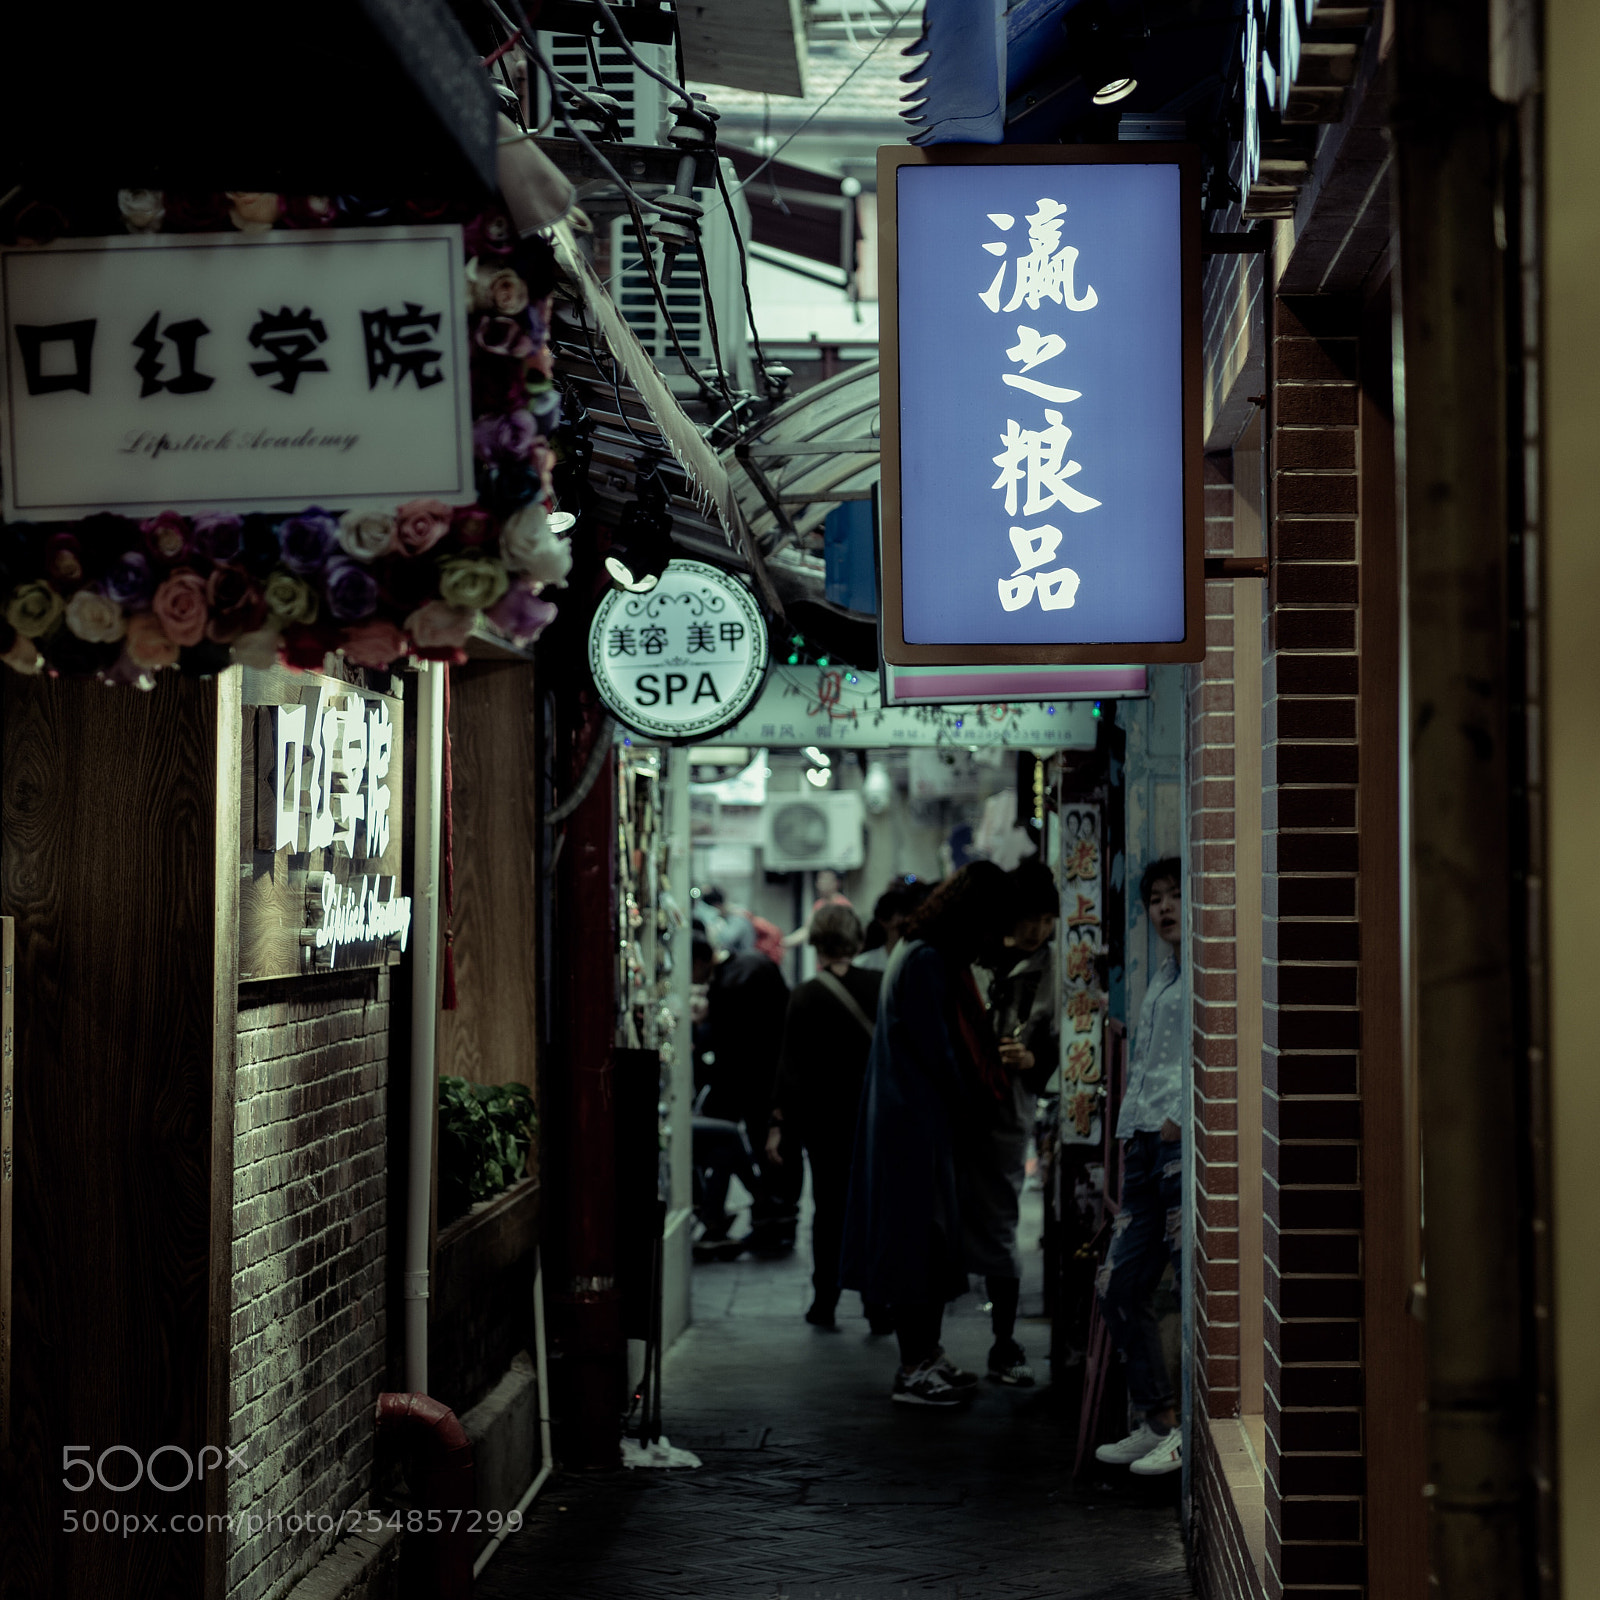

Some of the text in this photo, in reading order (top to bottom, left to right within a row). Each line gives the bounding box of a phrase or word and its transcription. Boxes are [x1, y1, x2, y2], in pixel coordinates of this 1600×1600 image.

[14, 302, 446, 398] 口红学院
[117, 427, 360, 459] Lipstick Academy
[608, 621, 744, 657] 美容 美甲
[635, 672, 721, 707] SPA
[276, 686, 393, 859] 口红学院
[1064, 840, 1101, 1138] 老上海雪花膏
